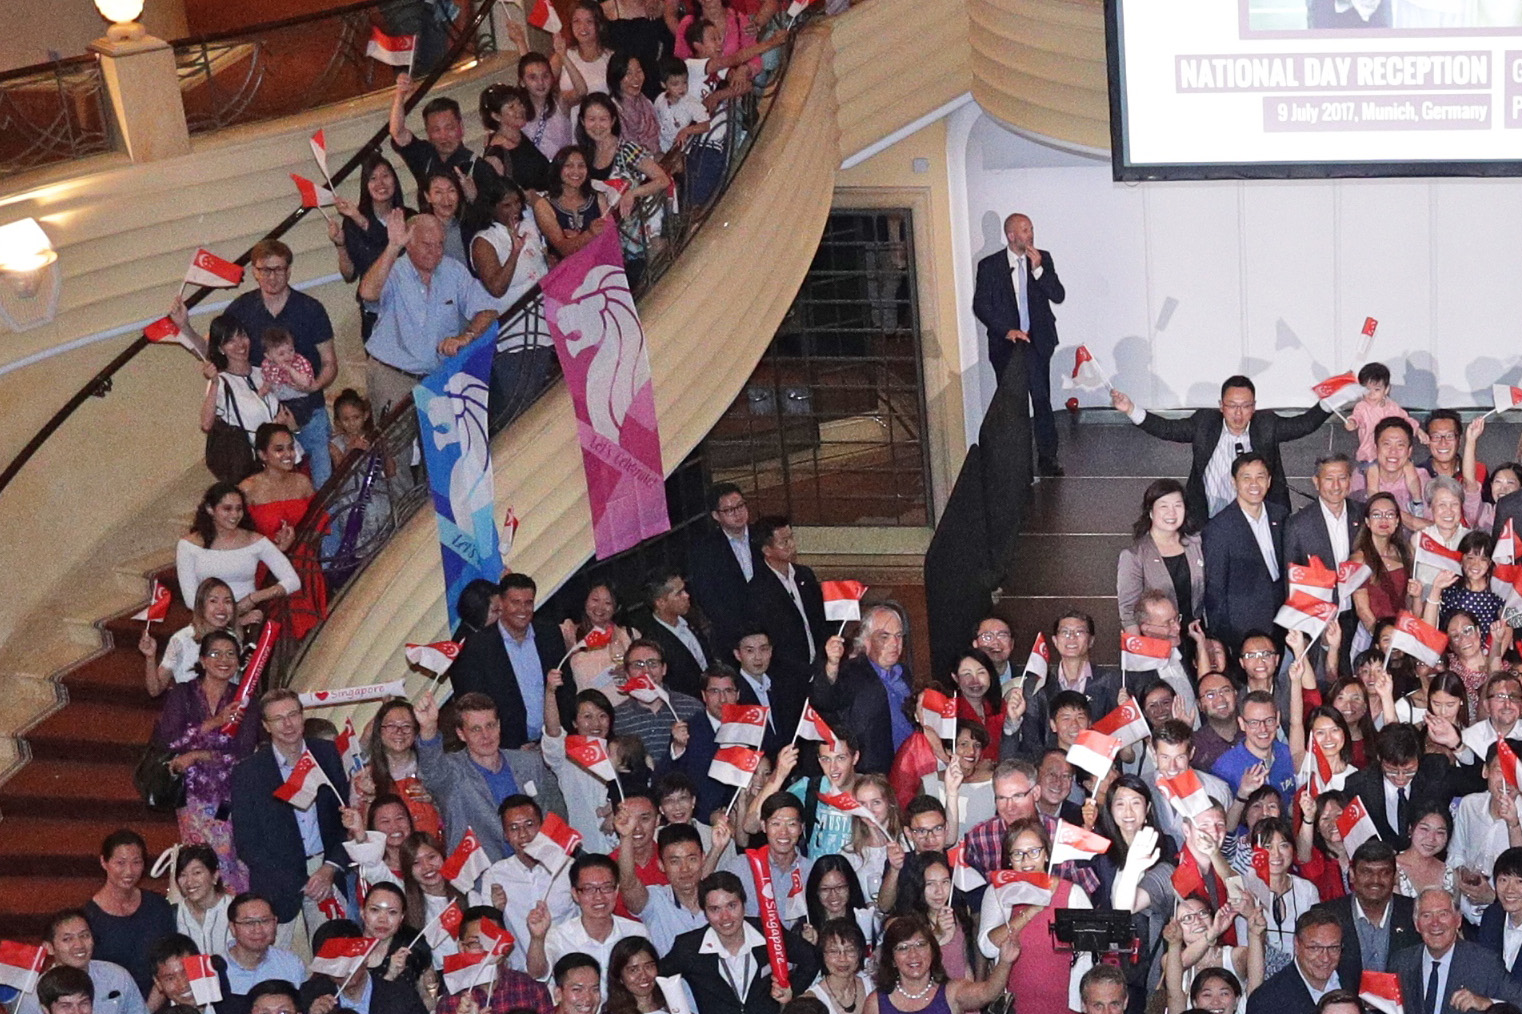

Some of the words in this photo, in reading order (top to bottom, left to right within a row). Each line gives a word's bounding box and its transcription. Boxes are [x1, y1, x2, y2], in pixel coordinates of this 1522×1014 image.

[1179, 58, 1299, 88] NATIONAL
[1304, 57, 1351, 87] DAY
[1357, 55, 1488, 86] RECEPTION
[1277, 104, 1287, 122] 9
[1290, 103, 1319, 125] July
[1322, 103, 1358, 124] 2017,
[1362, 102, 1419, 123] Munich,
[1421, 101, 1488, 123] Germany
[331, 685, 385, 700] Singapore
[765, 902, 785, 965] Singapore
